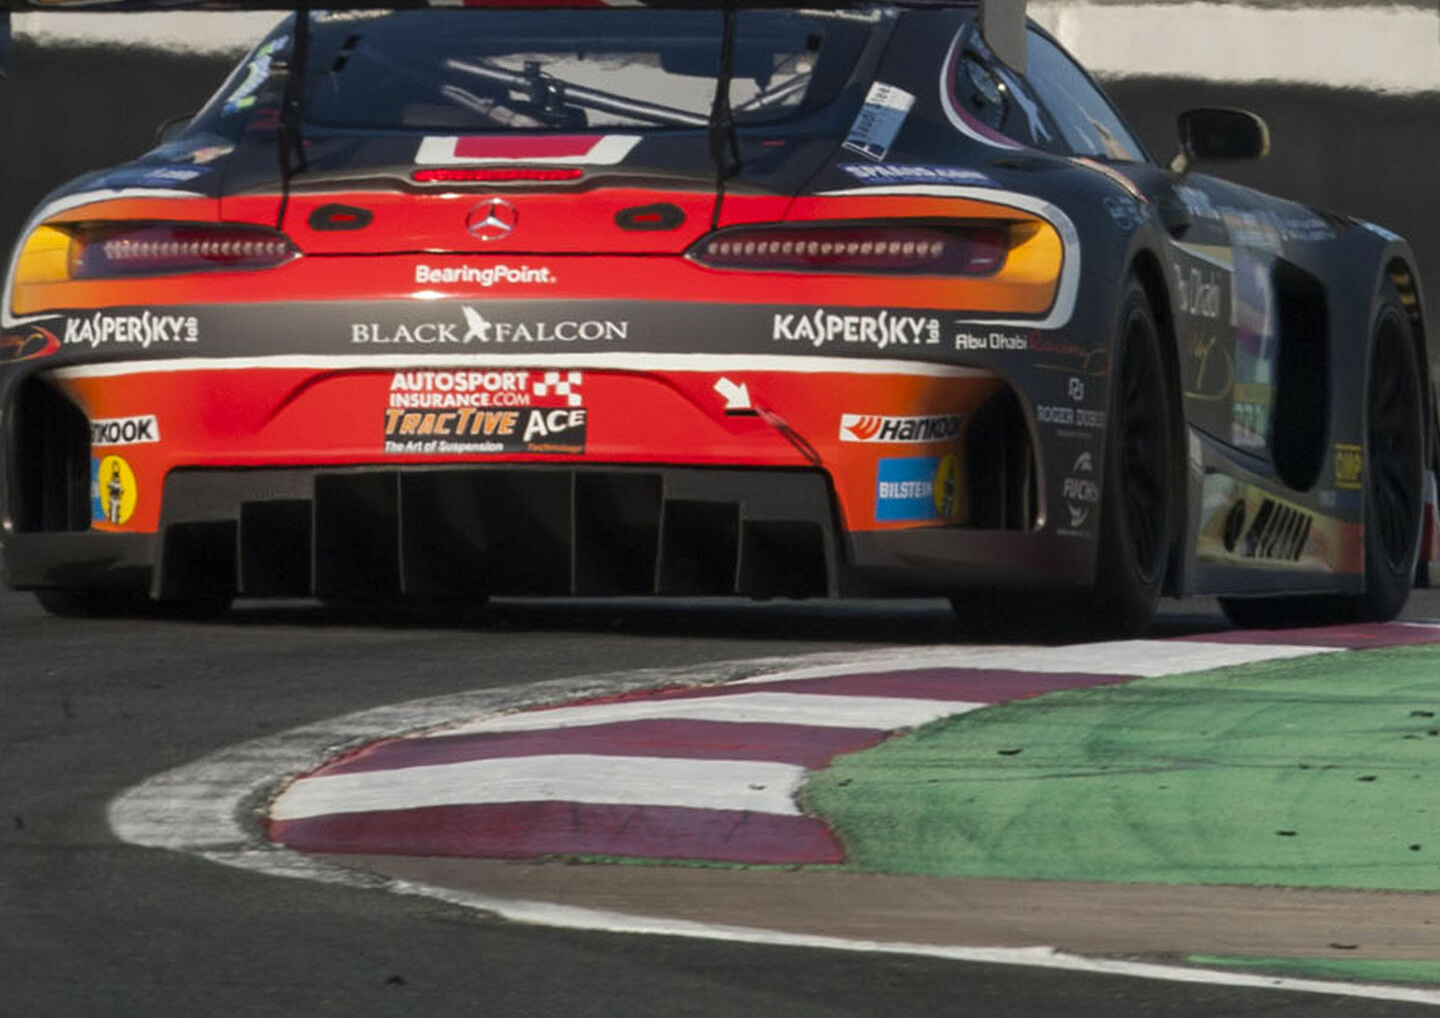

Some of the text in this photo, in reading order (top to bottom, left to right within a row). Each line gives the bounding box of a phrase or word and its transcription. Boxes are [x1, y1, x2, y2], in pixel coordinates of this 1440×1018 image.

[64, 310, 185, 349] KASPERSKY
[351, 320, 629, 344] BLACK FALCON
[772, 308, 927, 348] KASPERSKY
[955, 333, 987, 351] Abu
[989, 333, 1029, 351] Dhabi
[390, 371, 530, 392] AUTOSPORT
[389, 392, 531, 408] INSURANCE.COM
[523, 409, 587, 442] ACE
[384, 441, 405, 453] The
[405, 441, 424, 452] Art
[425, 440, 437, 453] of
